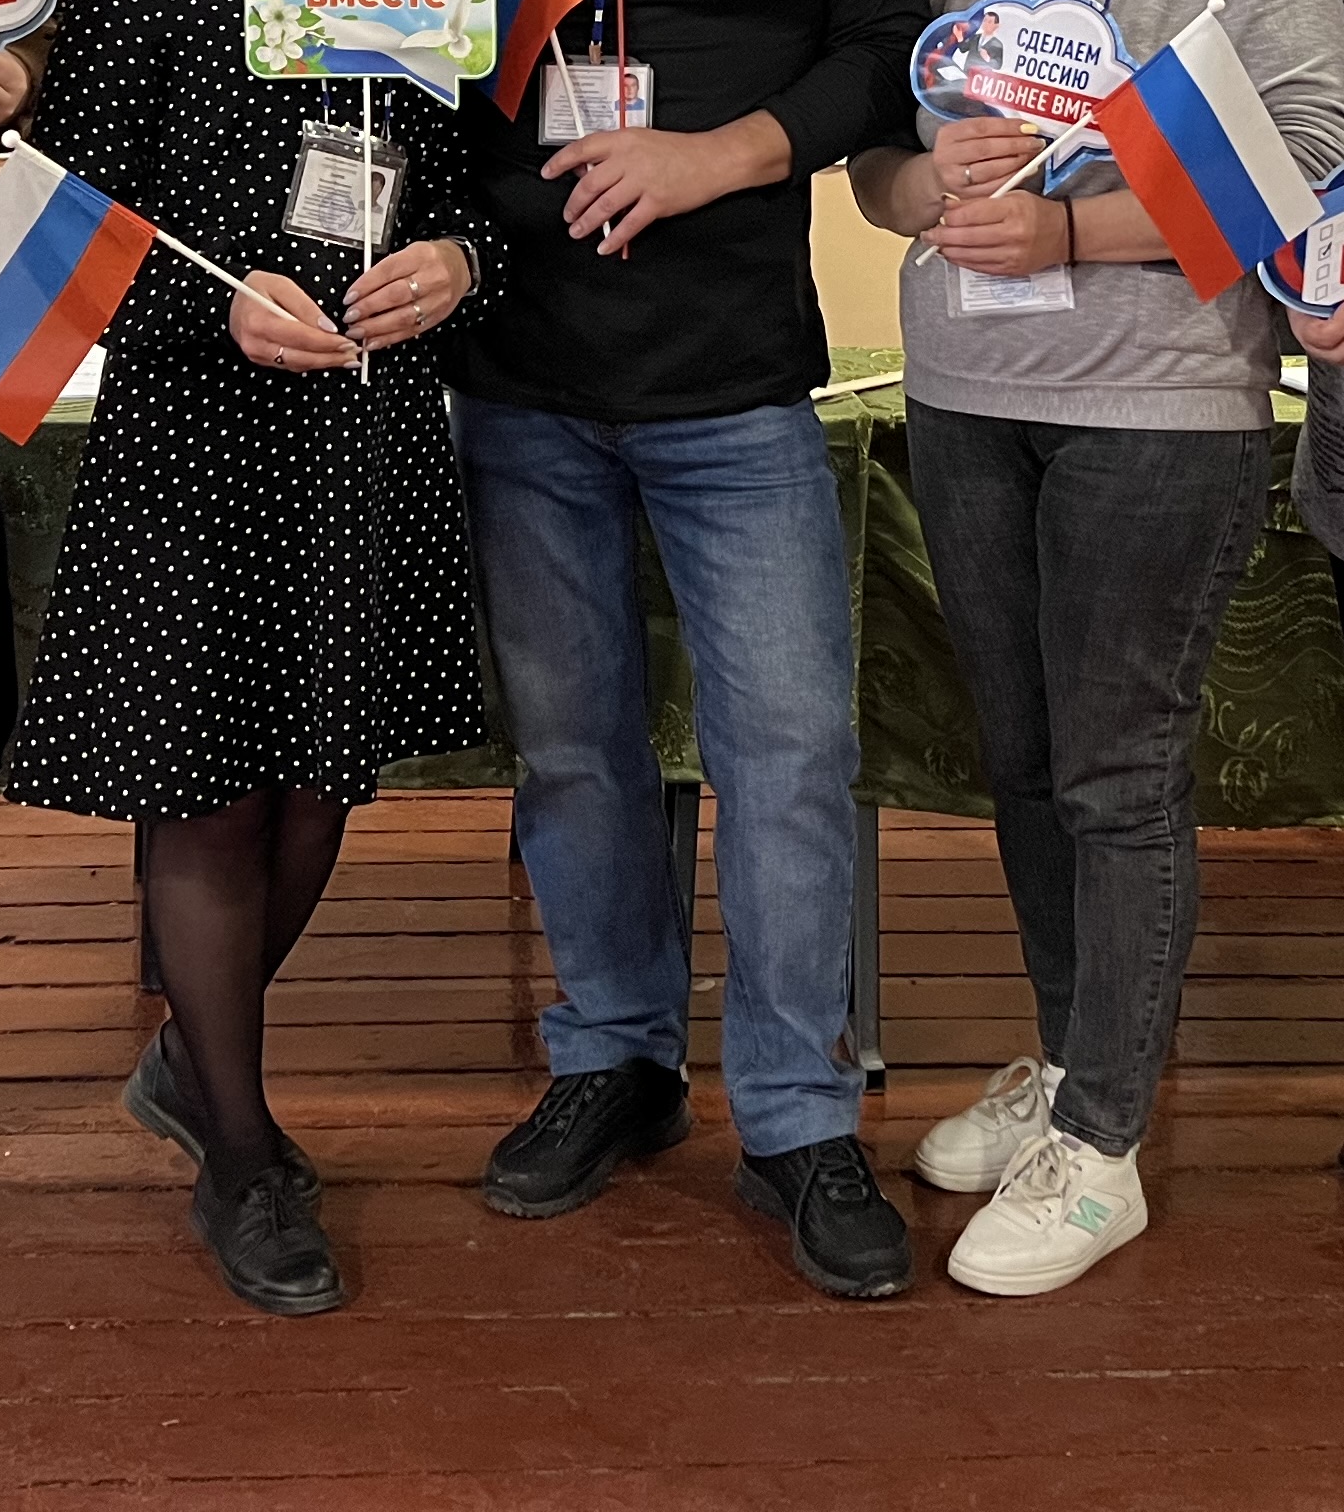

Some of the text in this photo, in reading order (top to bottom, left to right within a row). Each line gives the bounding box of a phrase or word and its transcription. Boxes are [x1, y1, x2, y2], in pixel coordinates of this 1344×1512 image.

[1017, 28, 1102, 66] СДЕЛАЕМ
[1014, 55, 1090, 90] РОССИЮ
[971, 74, 1099, 125] СИЛЬНЕЕ ВМЕ
